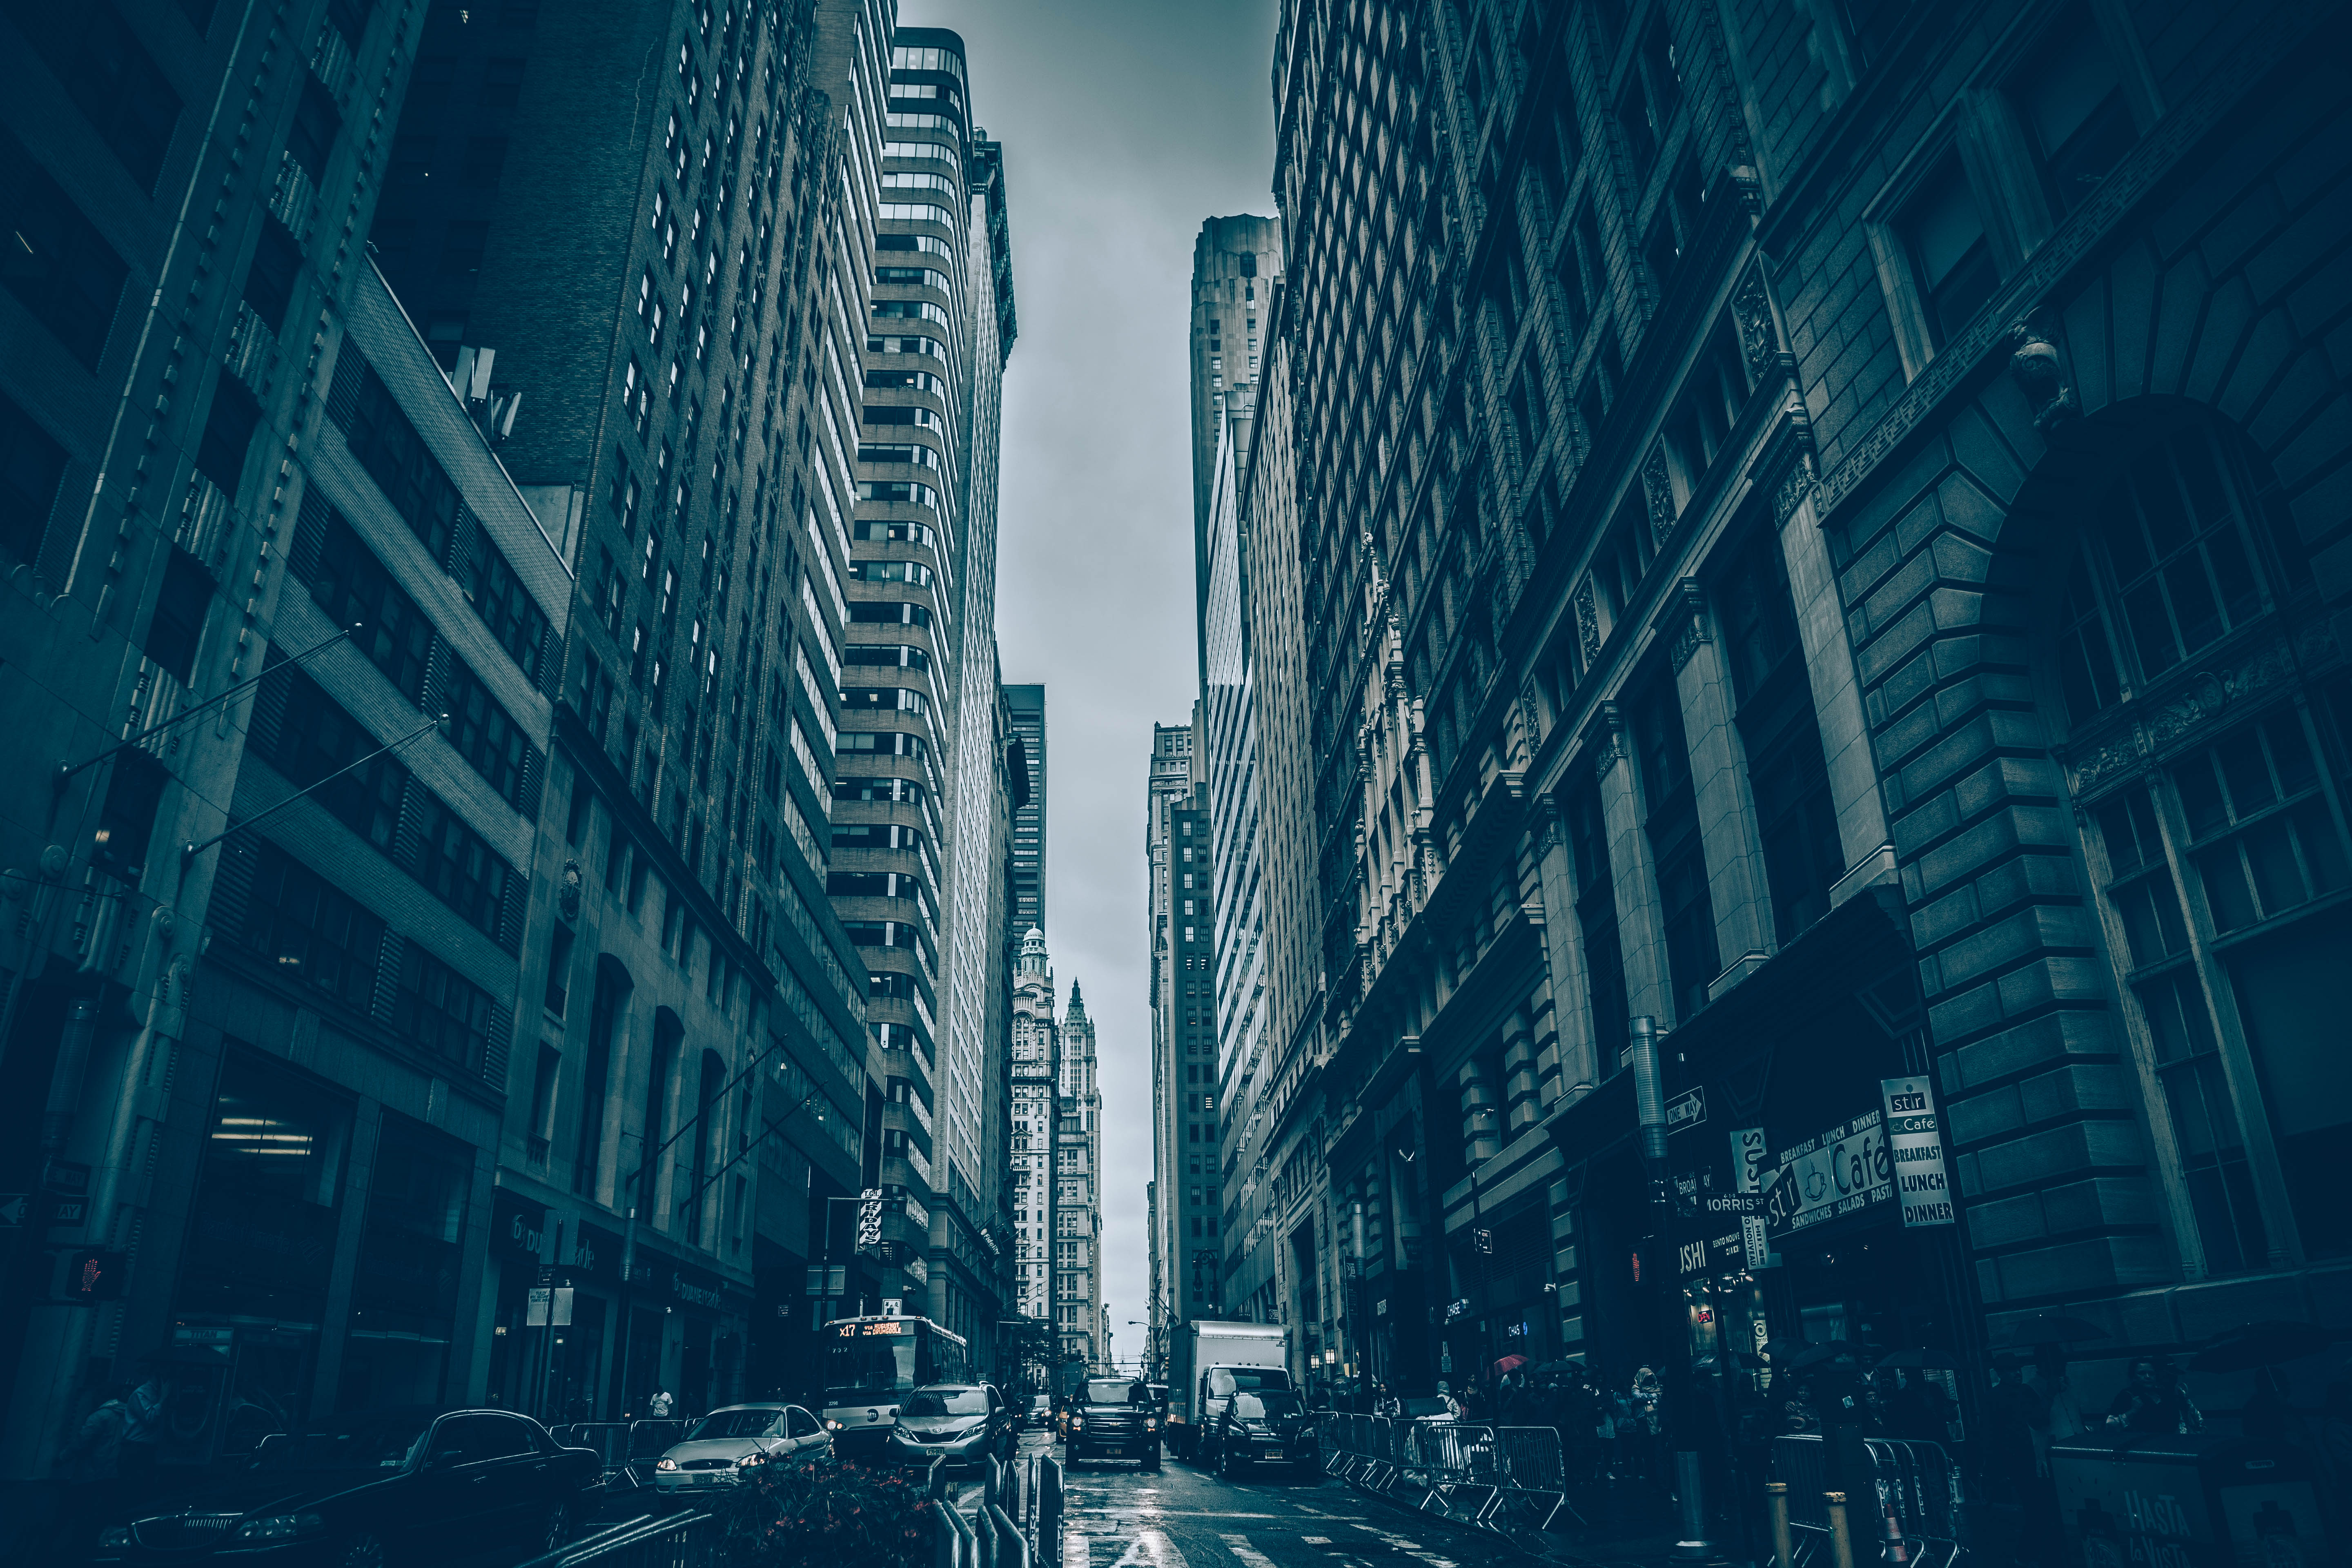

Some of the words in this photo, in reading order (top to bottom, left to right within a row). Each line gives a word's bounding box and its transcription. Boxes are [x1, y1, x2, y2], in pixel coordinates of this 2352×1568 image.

[1669, 1107, 1682, 1123] ONE
[1684, 1099, 1697, 1117] WAY
[1904, 1118, 1935, 1130] Café
[1781, 1138, 1815, 1163] BREAKFAST
[1822, 1125, 1845, 1145] LUNCH
[1852, 1110, 1881, 1133] DINNER
[1833, 1133, 1889, 1195] Café
[1893, 1145, 1941, 1163] BREAKFAST
[1901, 1173, 1945, 1192] LUNCH
[58, 1205, 78, 1218] AY
[1792, 1205, 1832, 1229] SANDWICHES
[1838, 1194, 1865, 1214] SALADS
[1904, 1202, 1953, 1223] DINNER
[1713, 1237, 1725, 1248] BENTO
[1725, 1232, 1740, 1244] NOUVE
[1745, 1227, 1756, 1266] NOUVEAU
[1448, 1302, 1460, 1317] CHASE
[1508, 1324, 1520, 1336] CHAS
[2124, 1490, 2191, 1538] HASTA
[2129, 1537, 2144, 1561] la
